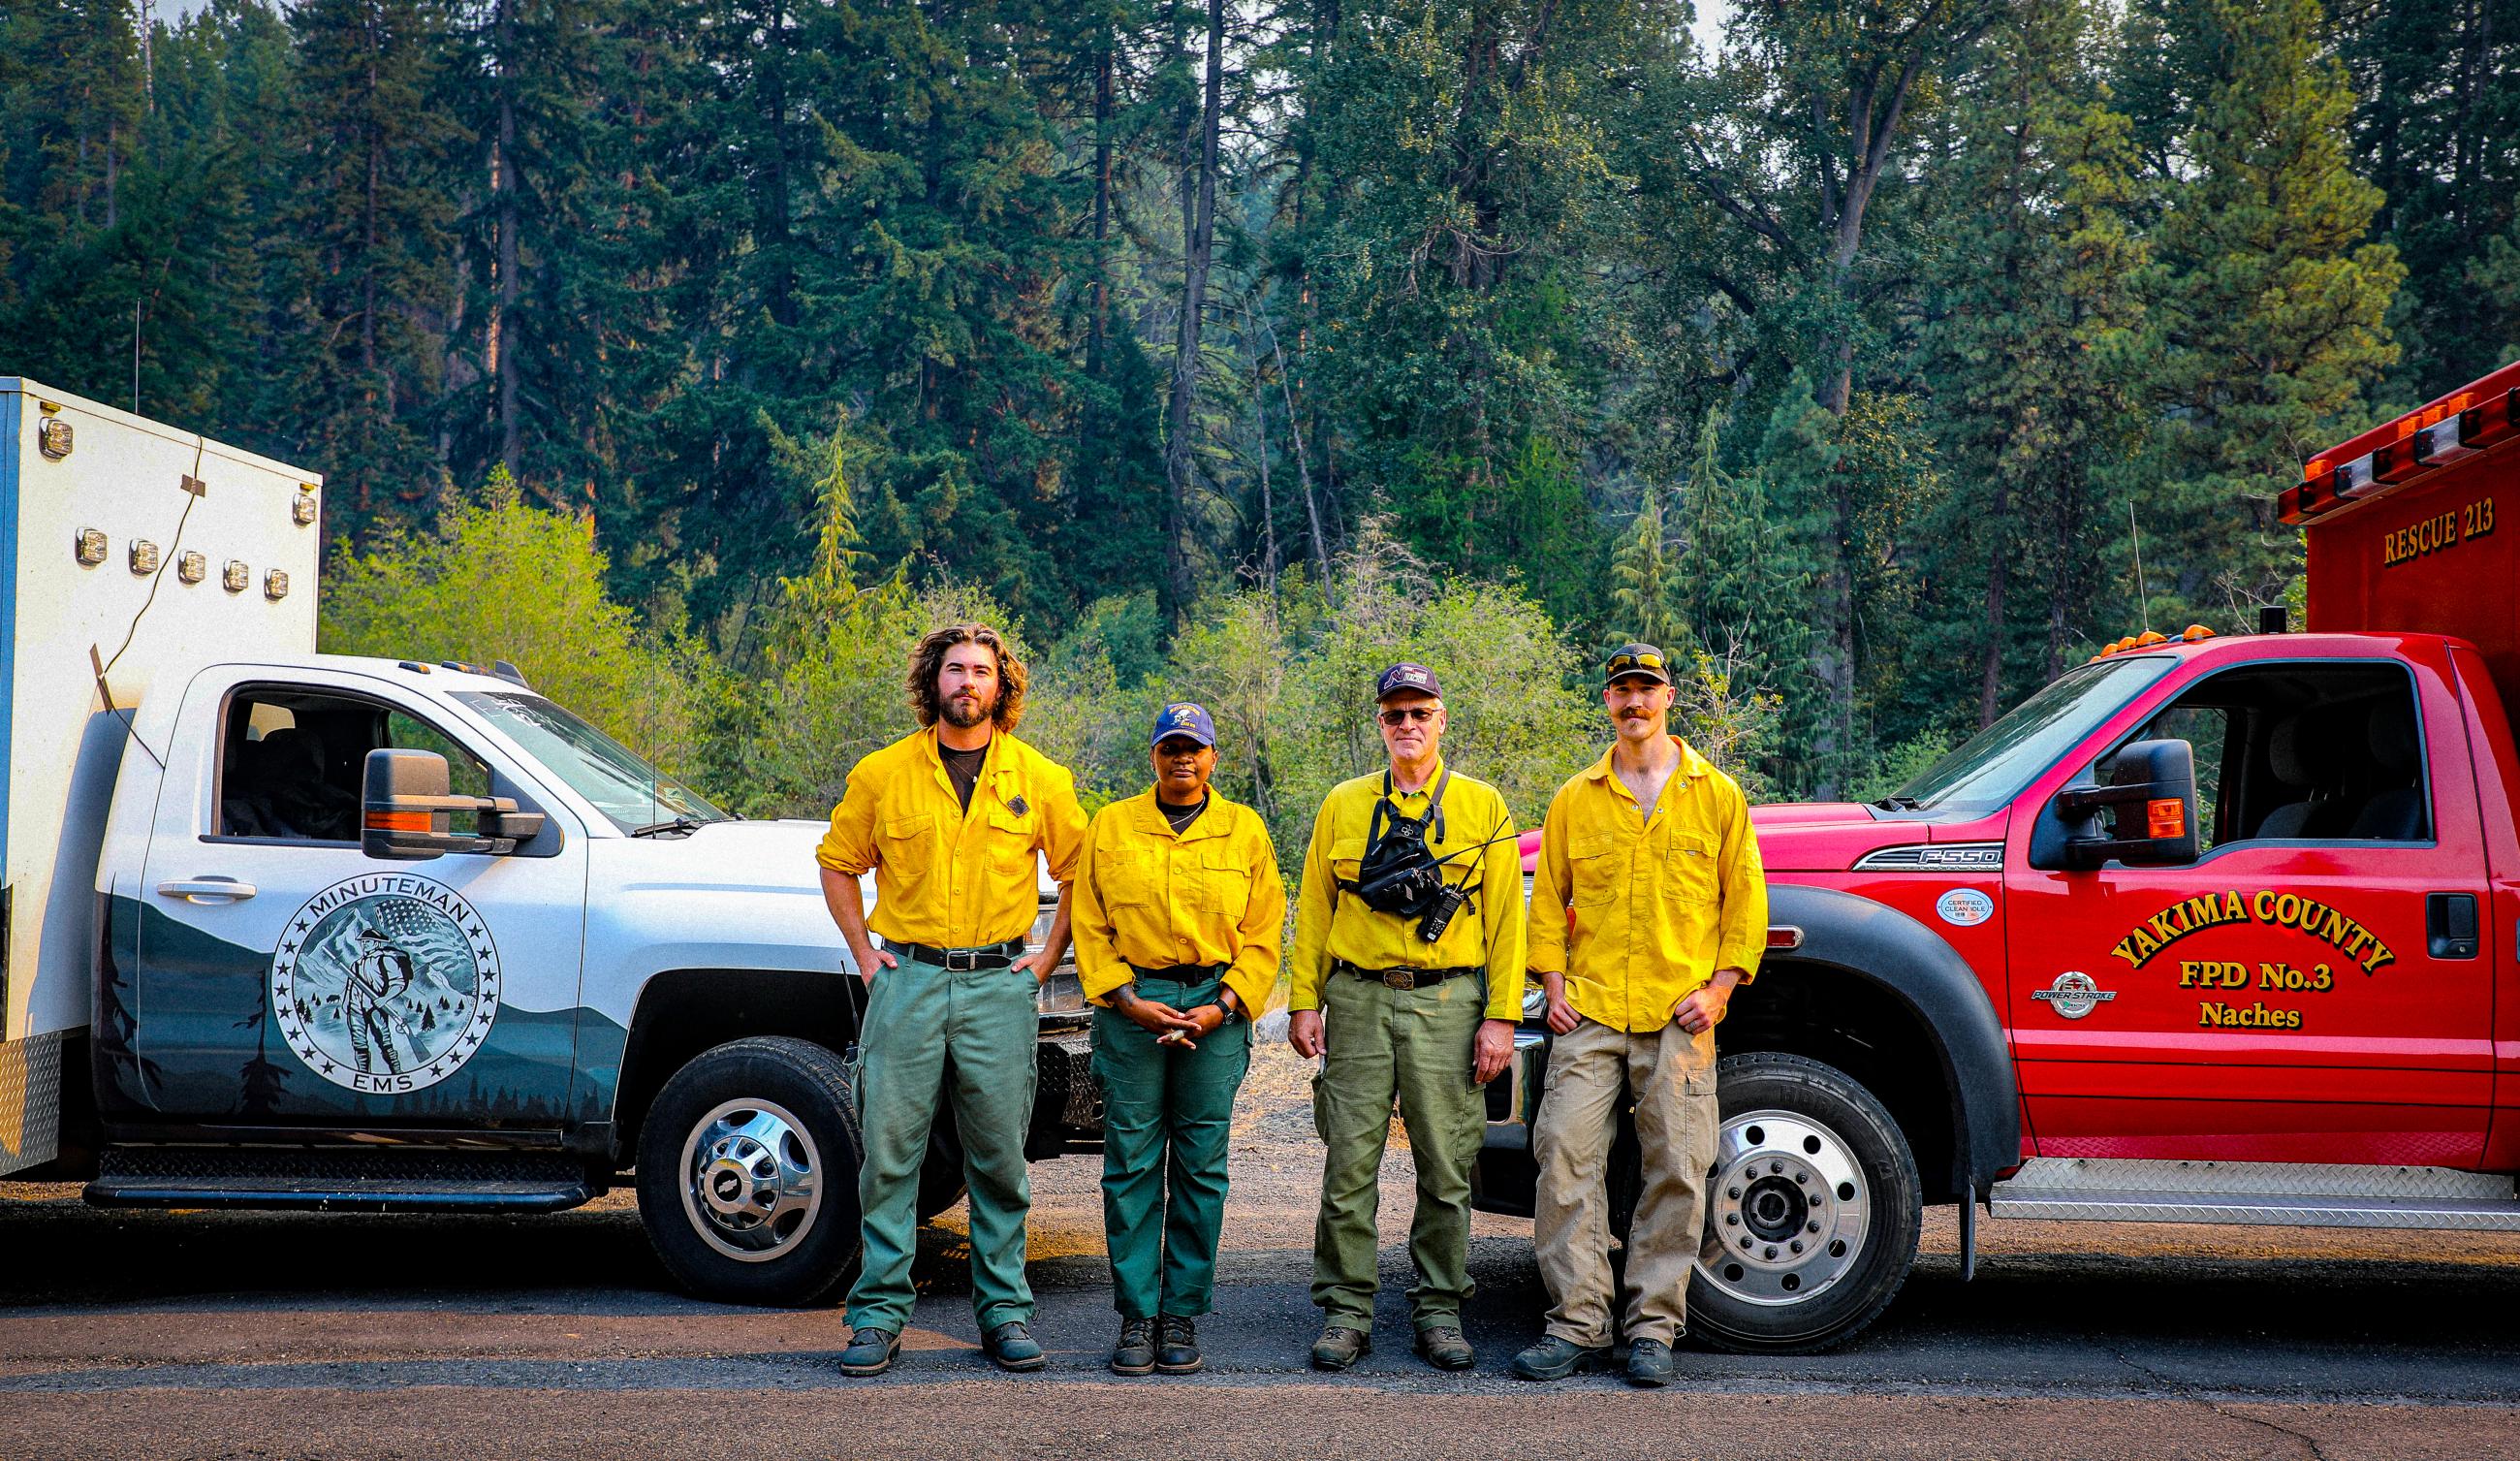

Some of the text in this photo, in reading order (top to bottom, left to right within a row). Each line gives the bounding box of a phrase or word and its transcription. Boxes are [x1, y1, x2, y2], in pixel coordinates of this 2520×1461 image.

[2383, 496, 2495, 565] RESCUE 213
[1917, 848, 2001, 865] F-550
[308, 876, 470, 923] MINUTEMAN
[2111, 890, 2395, 973] YAKIMA COUNTY
[2179, 961, 2333, 990] FPD No.3
[2032, 991, 2117, 1000] POWER STROKE
[2199, 1001, 2302, 1028] Naches
[352, 1074, 414, 1093] EMS
